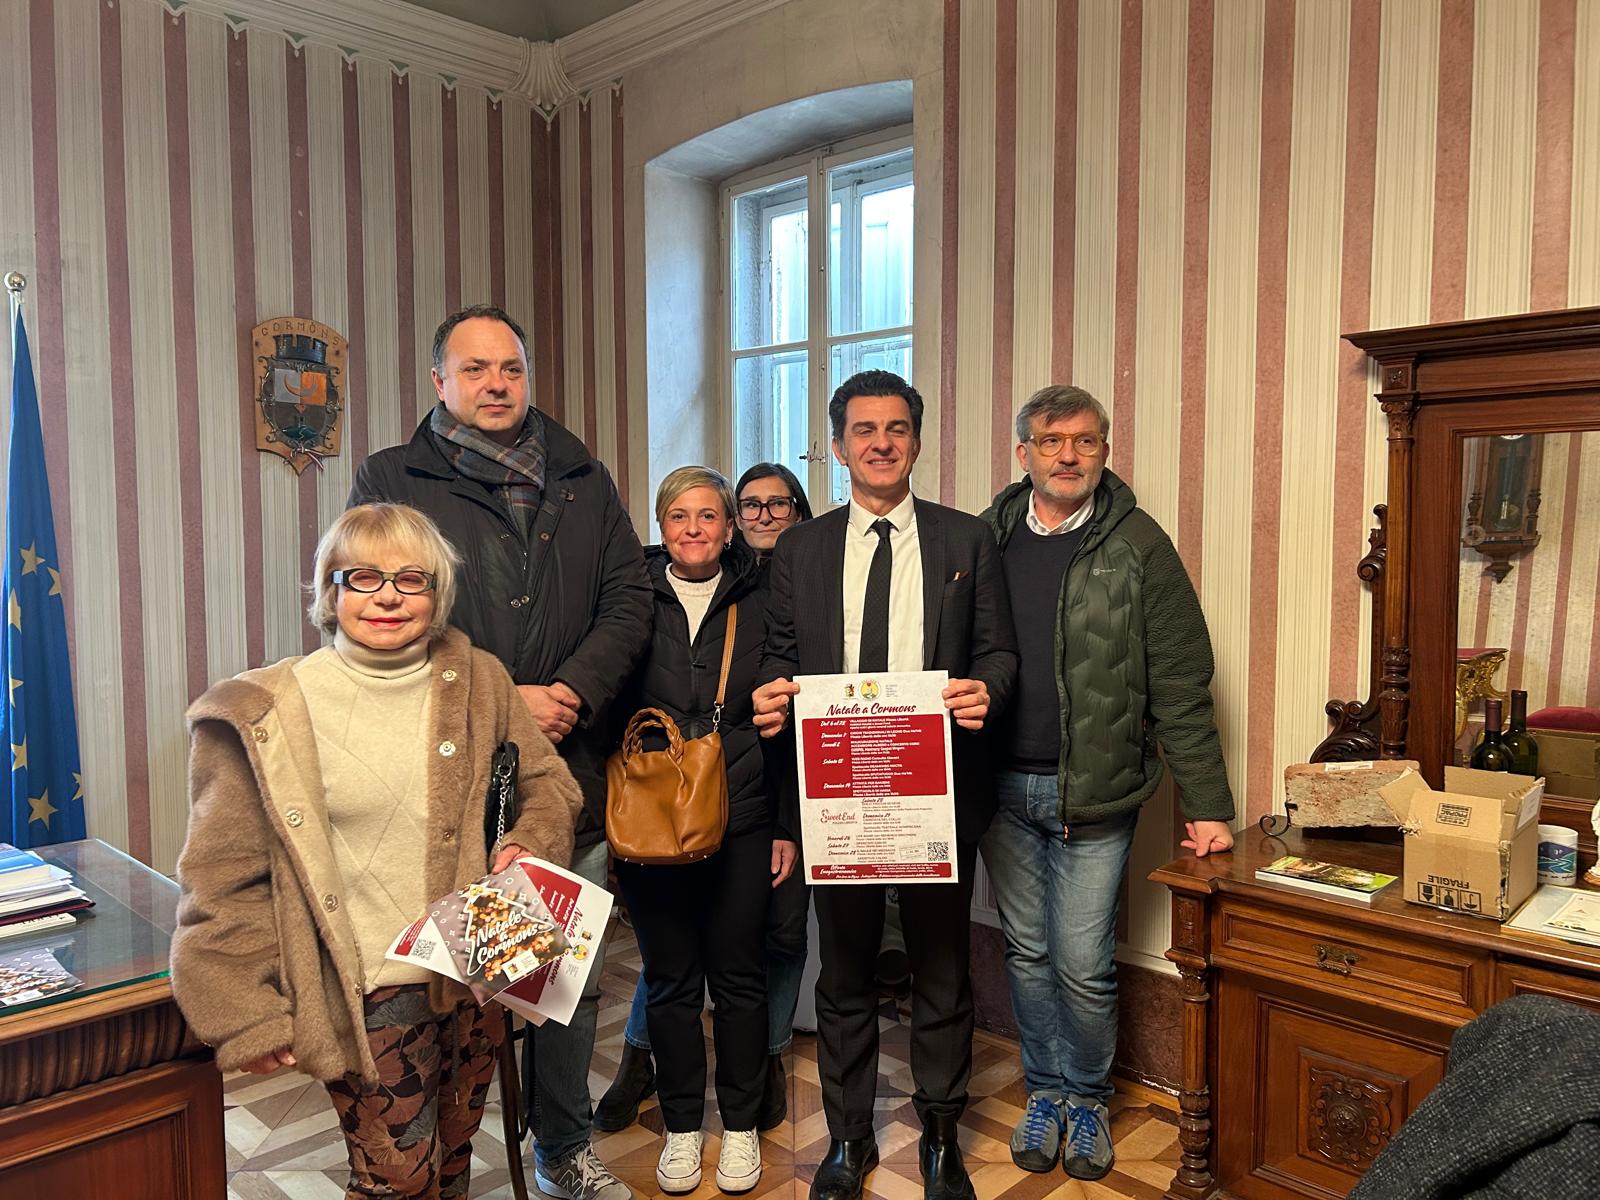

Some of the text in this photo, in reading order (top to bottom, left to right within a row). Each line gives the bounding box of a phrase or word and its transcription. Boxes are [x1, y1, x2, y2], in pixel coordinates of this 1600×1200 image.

[825, 703, 861, 716] Natale
[870, 702, 917, 714] Cormons
[820, 808, 856, 824] Sweet End
[1428, 875, 1469, 889] FRAGILE
[477, 911, 522, 947] Natale
[567, 907, 583, 938] Natale
[477, 923, 539, 965] Cormons
[500, 931, 509, 941] a
